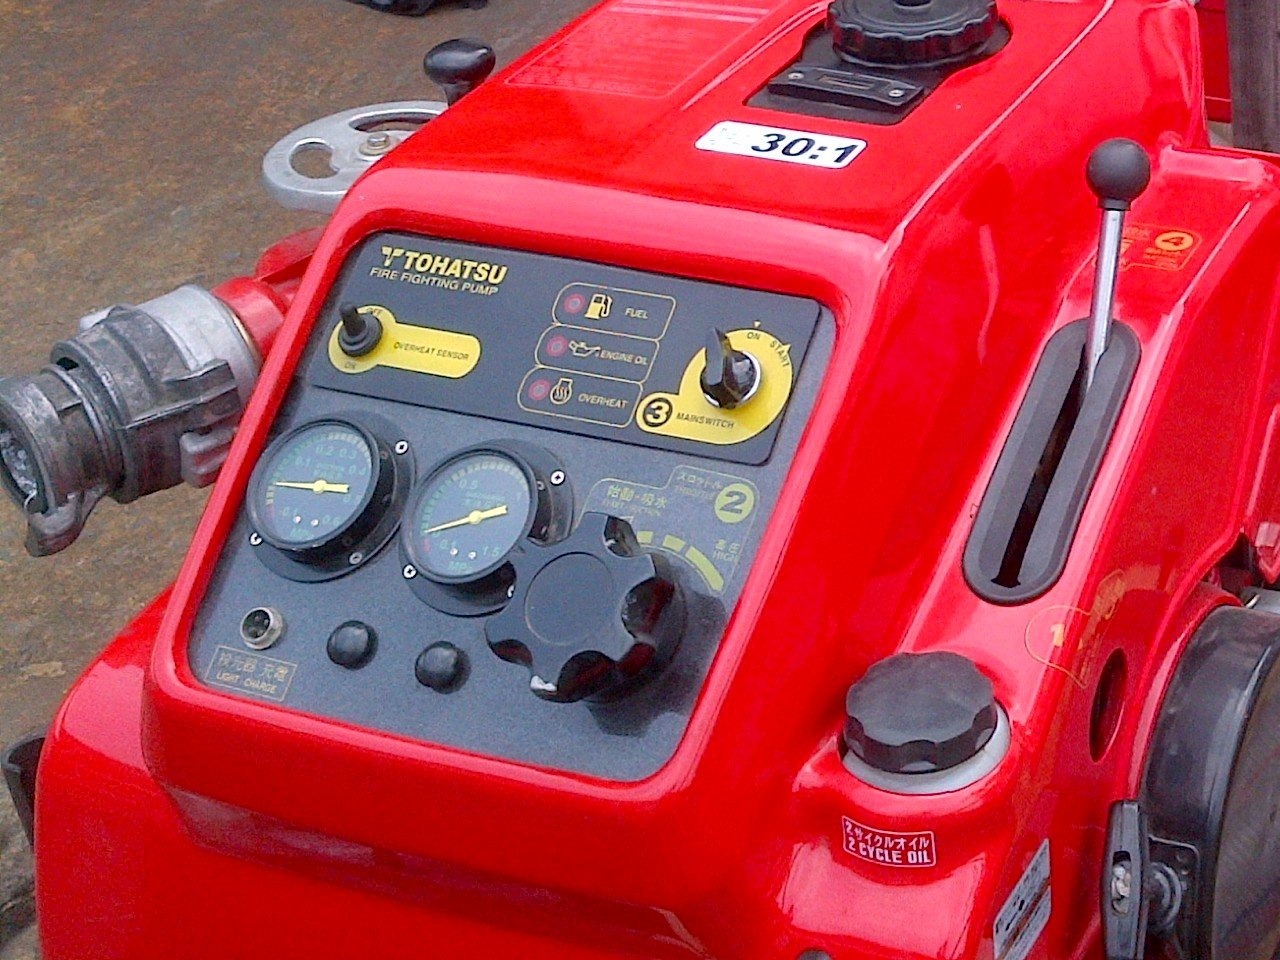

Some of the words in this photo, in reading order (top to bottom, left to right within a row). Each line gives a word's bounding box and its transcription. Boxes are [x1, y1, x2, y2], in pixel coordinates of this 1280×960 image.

[751, 133, 858, 163] 30:1
[403, 250, 508, 285] TOHATSU
[370, 267, 398, 280] FIRE
[400, 272, 459, 290] FIGHTING
[462, 282, 499, 296] PUMP
[625, 308, 649, 320] FUEL
[746, 331, 761, 341] ON
[393, 342, 435, 355] OVERHEAT
[436, 349, 470, 361] SENSOR
[601, 350, 634, 363] ENGINE
[634, 356, 649, 366] OIL
[769, 341, 790, 368] START
[577, 393, 629, 409] OVERHEAT
[645, 401, 670, 424] 3
[676, 412, 735, 429] MAINSWITCH
[718, 490, 748, 514] 2
[243, 677, 278, 694] CHARGE
[845, 820, 930, 851] 2サイクルオイル
[848, 837, 856, 851] 2
[858, 842, 903, 864] CYCLE
[907, 850, 932, 864] OIL
